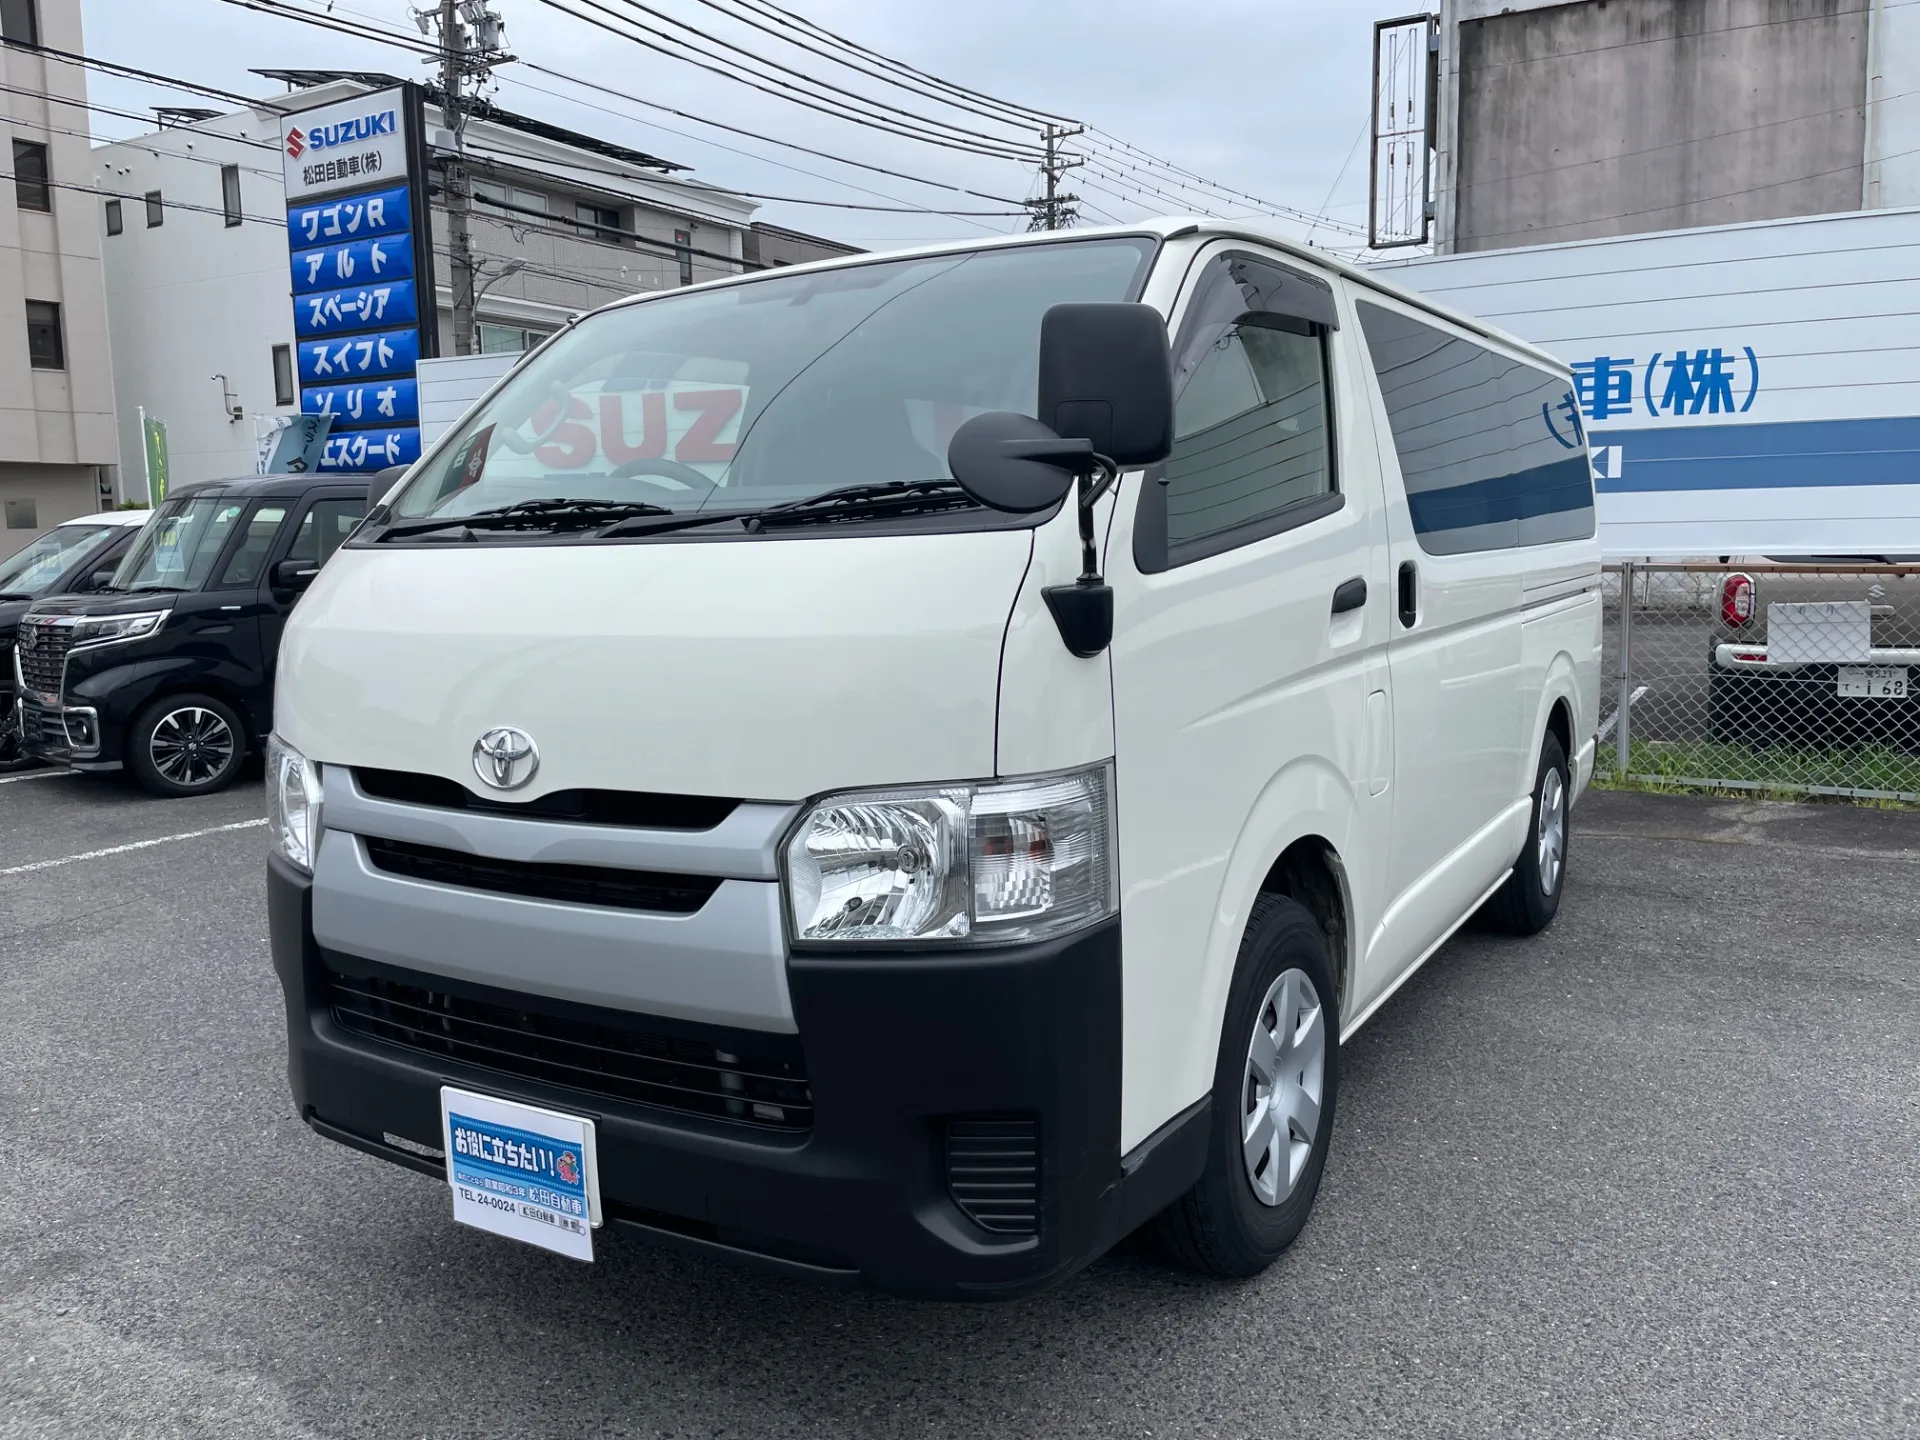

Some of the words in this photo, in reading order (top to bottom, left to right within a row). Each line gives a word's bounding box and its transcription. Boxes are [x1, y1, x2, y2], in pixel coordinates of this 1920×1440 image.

[308, 110, 396, 150] SUZUKI
[303, 150, 382, 186] 松田自動車(株)
[301, 198, 386, 241] ワゴンR
[305, 243, 387, 284] アルト
[309, 287, 391, 328] スペーシア
[313, 338, 394, 375] スイフト
[315, 386, 397, 419] ソリオ
[320, 433, 401, 468] エスクード
[459, 1187, 476, 1202] TEL
[477, 1193, 516, 1213] 24-0024
[528, 1186, 583, 1216] 松田自動車
